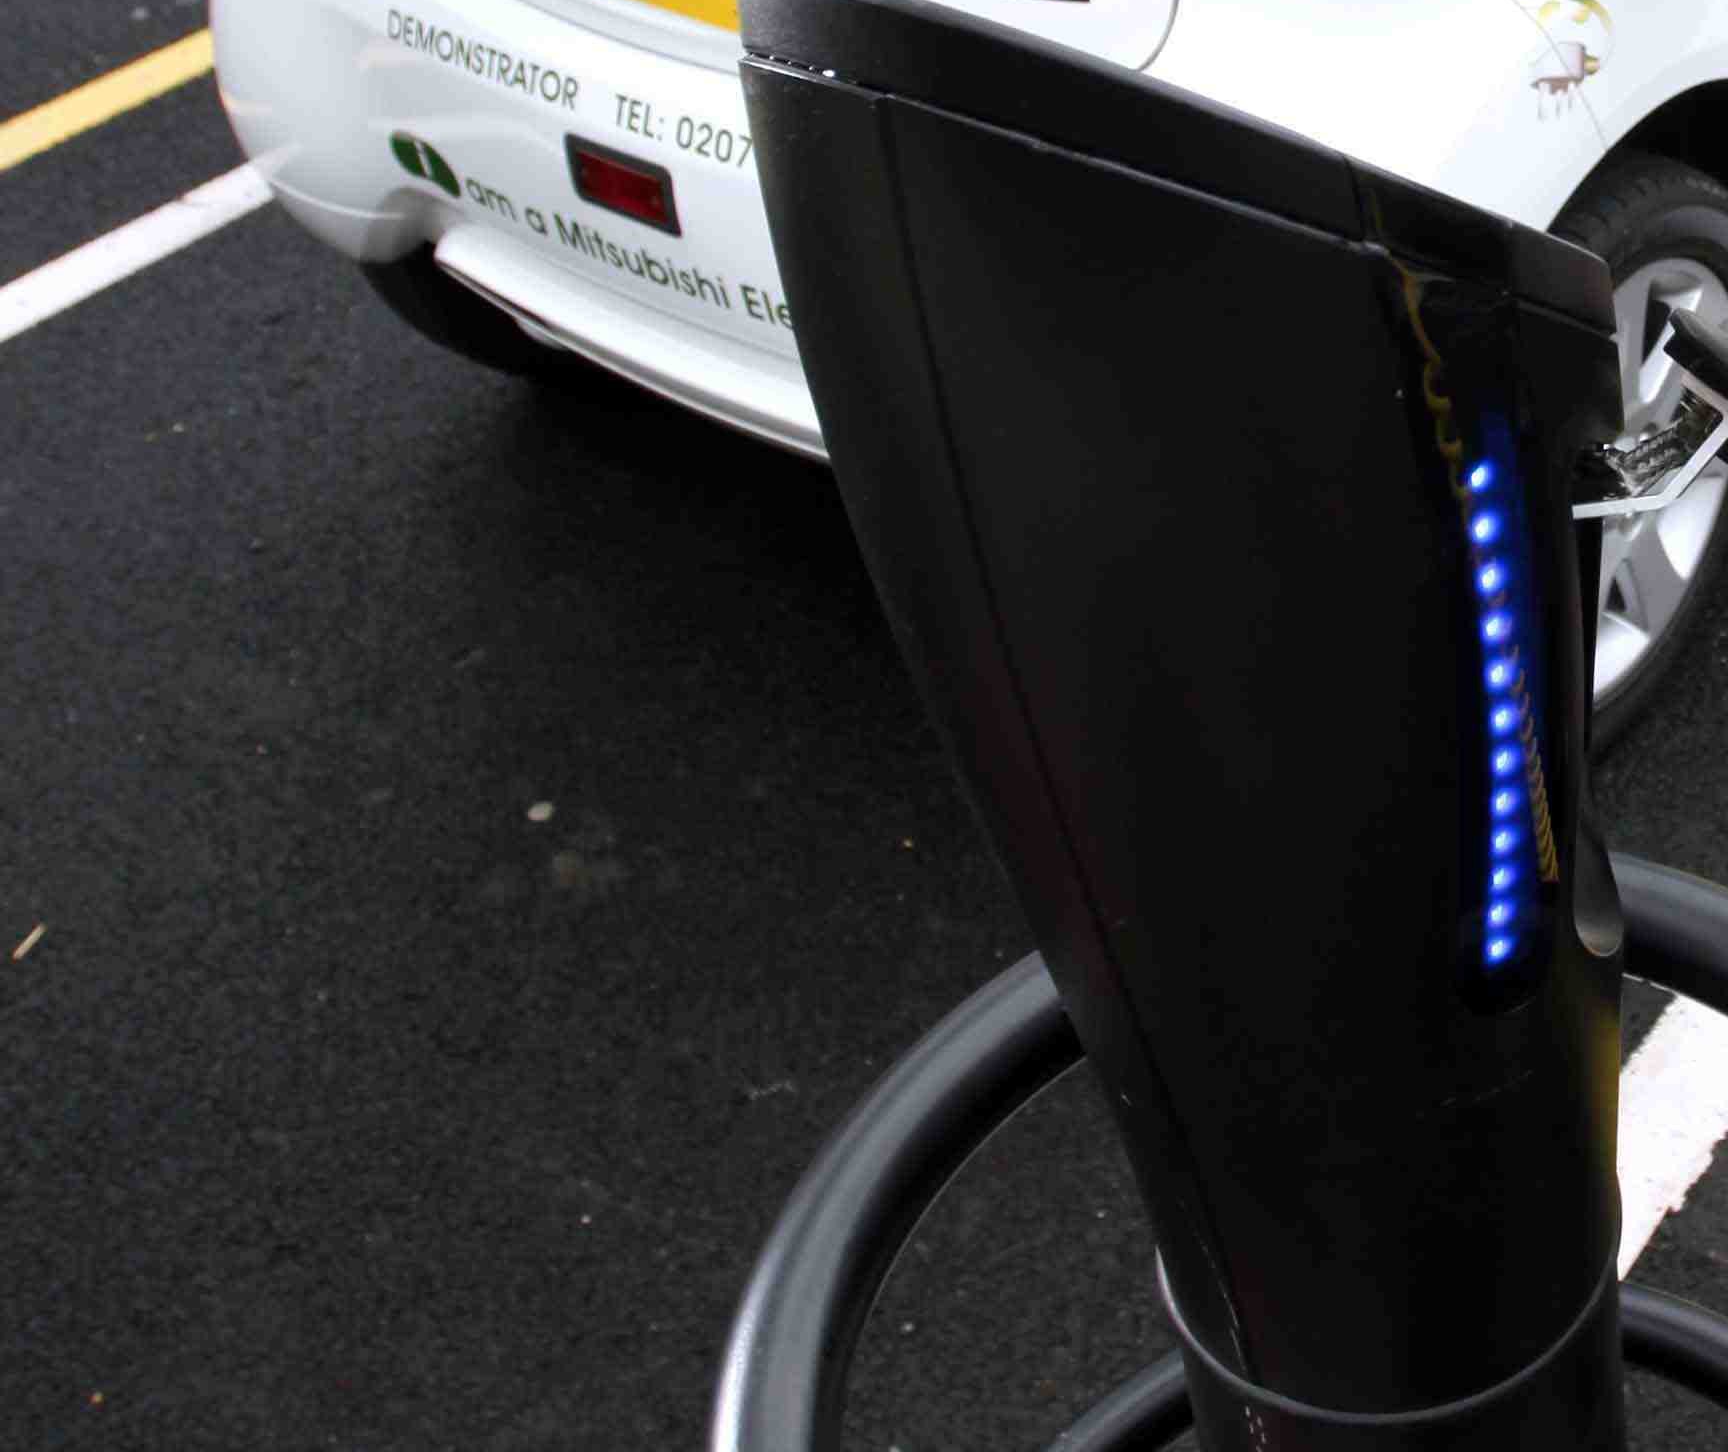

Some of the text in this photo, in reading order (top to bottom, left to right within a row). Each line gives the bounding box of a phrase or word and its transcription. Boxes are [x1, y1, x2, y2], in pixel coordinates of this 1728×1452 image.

[387, 8, 752, 168] DEMONSTRATOR TEL: 0207
[466, 176, 518, 224] am
[525, 207, 549, 237] a
[553, 212, 732, 310] Mitsubishi
